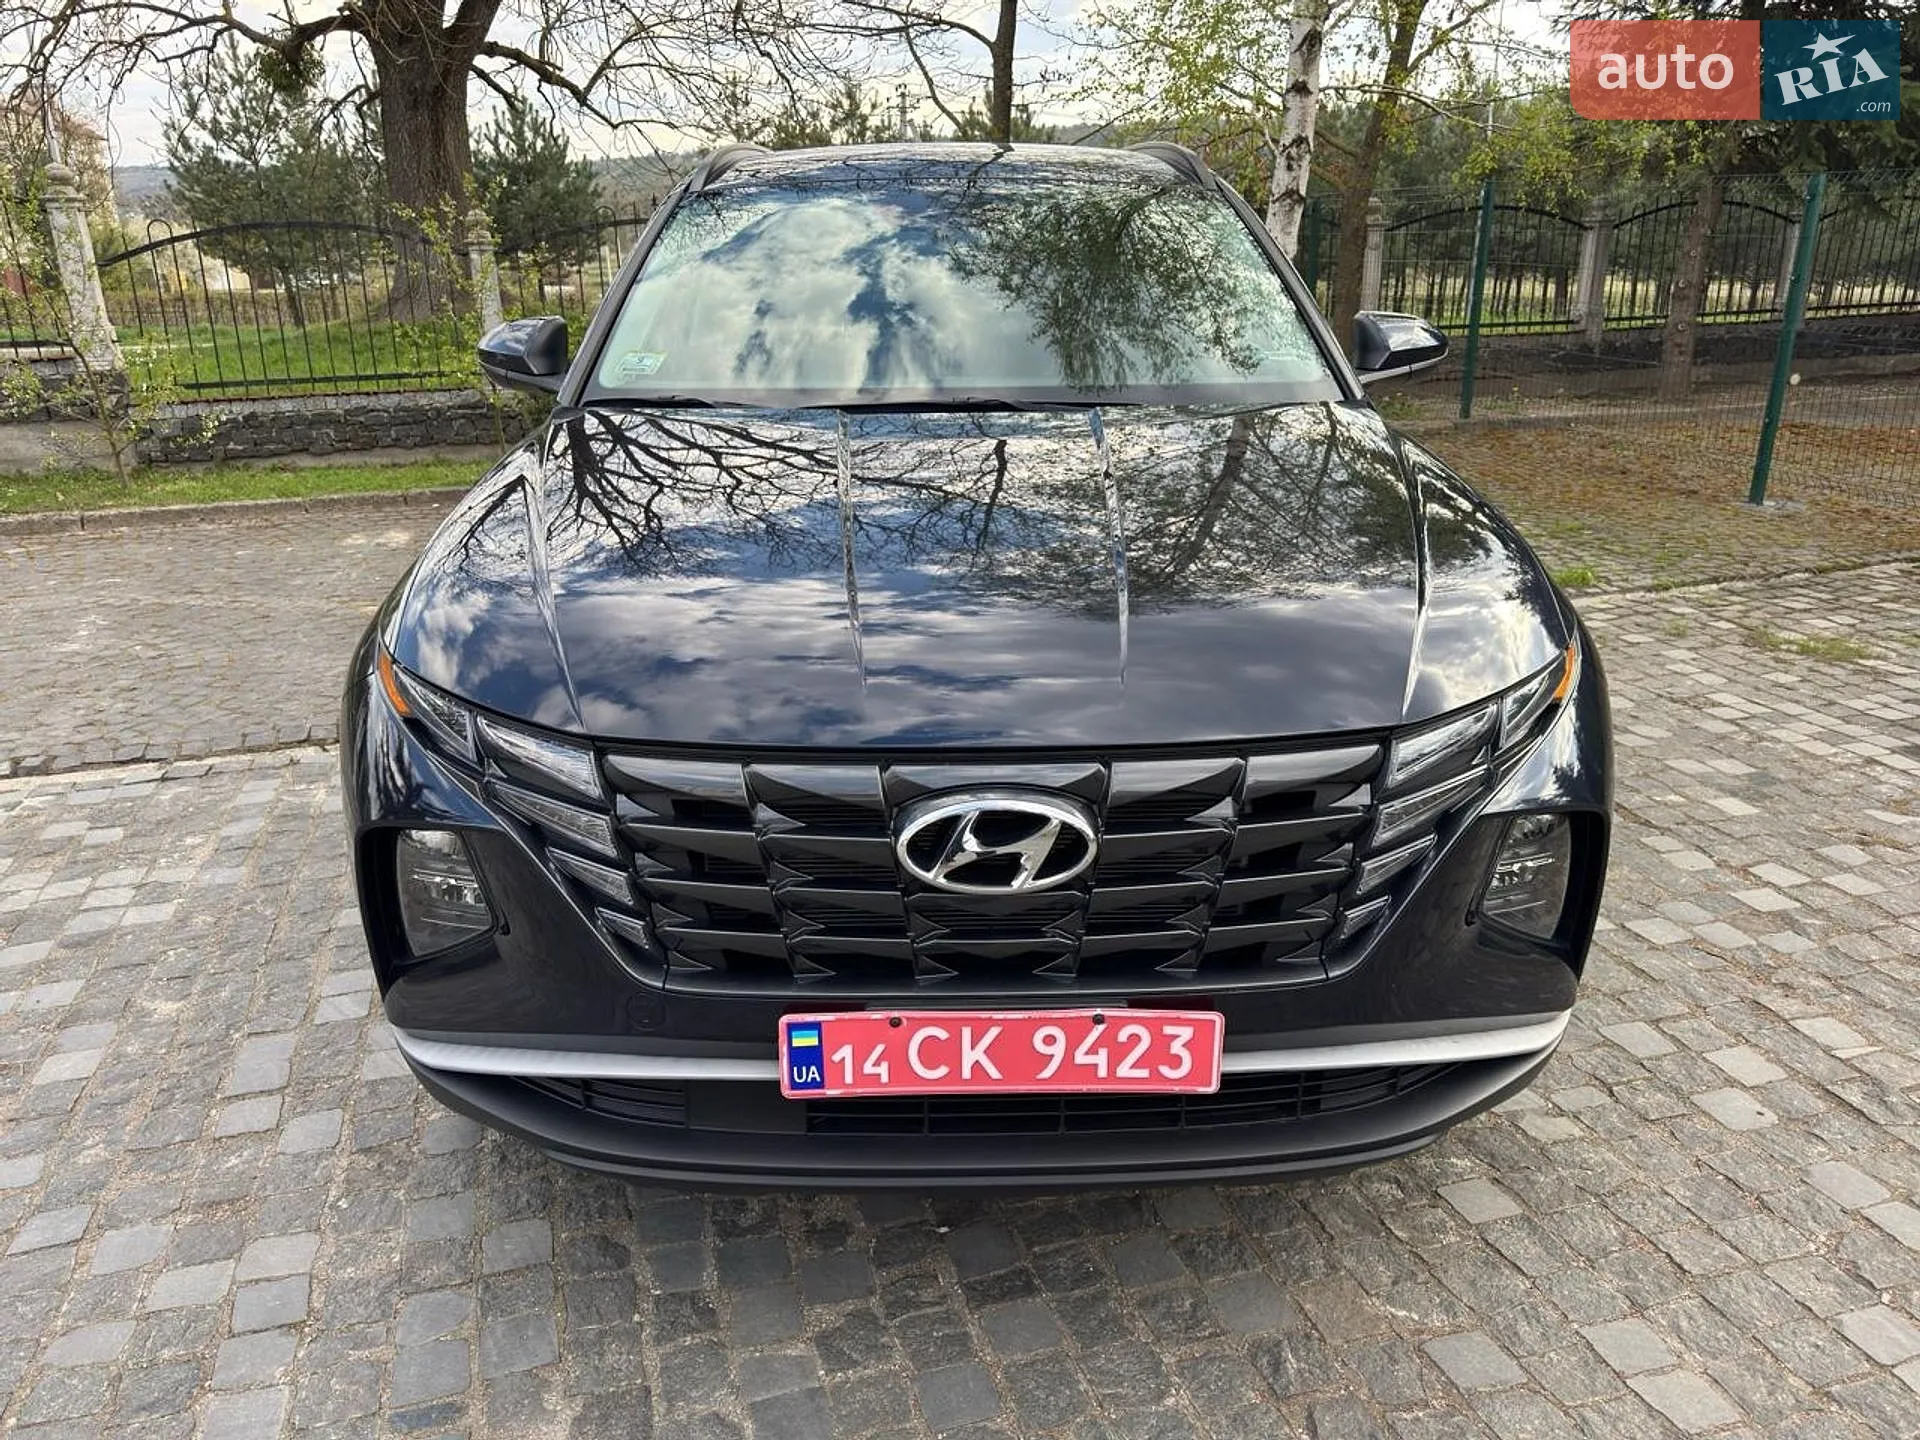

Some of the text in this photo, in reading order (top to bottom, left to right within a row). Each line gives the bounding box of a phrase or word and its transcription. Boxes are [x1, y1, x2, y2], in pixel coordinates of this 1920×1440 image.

[831, 1024, 1196, 1084] 14 CK 9423
[793, 1065, 821, 1084] UA
